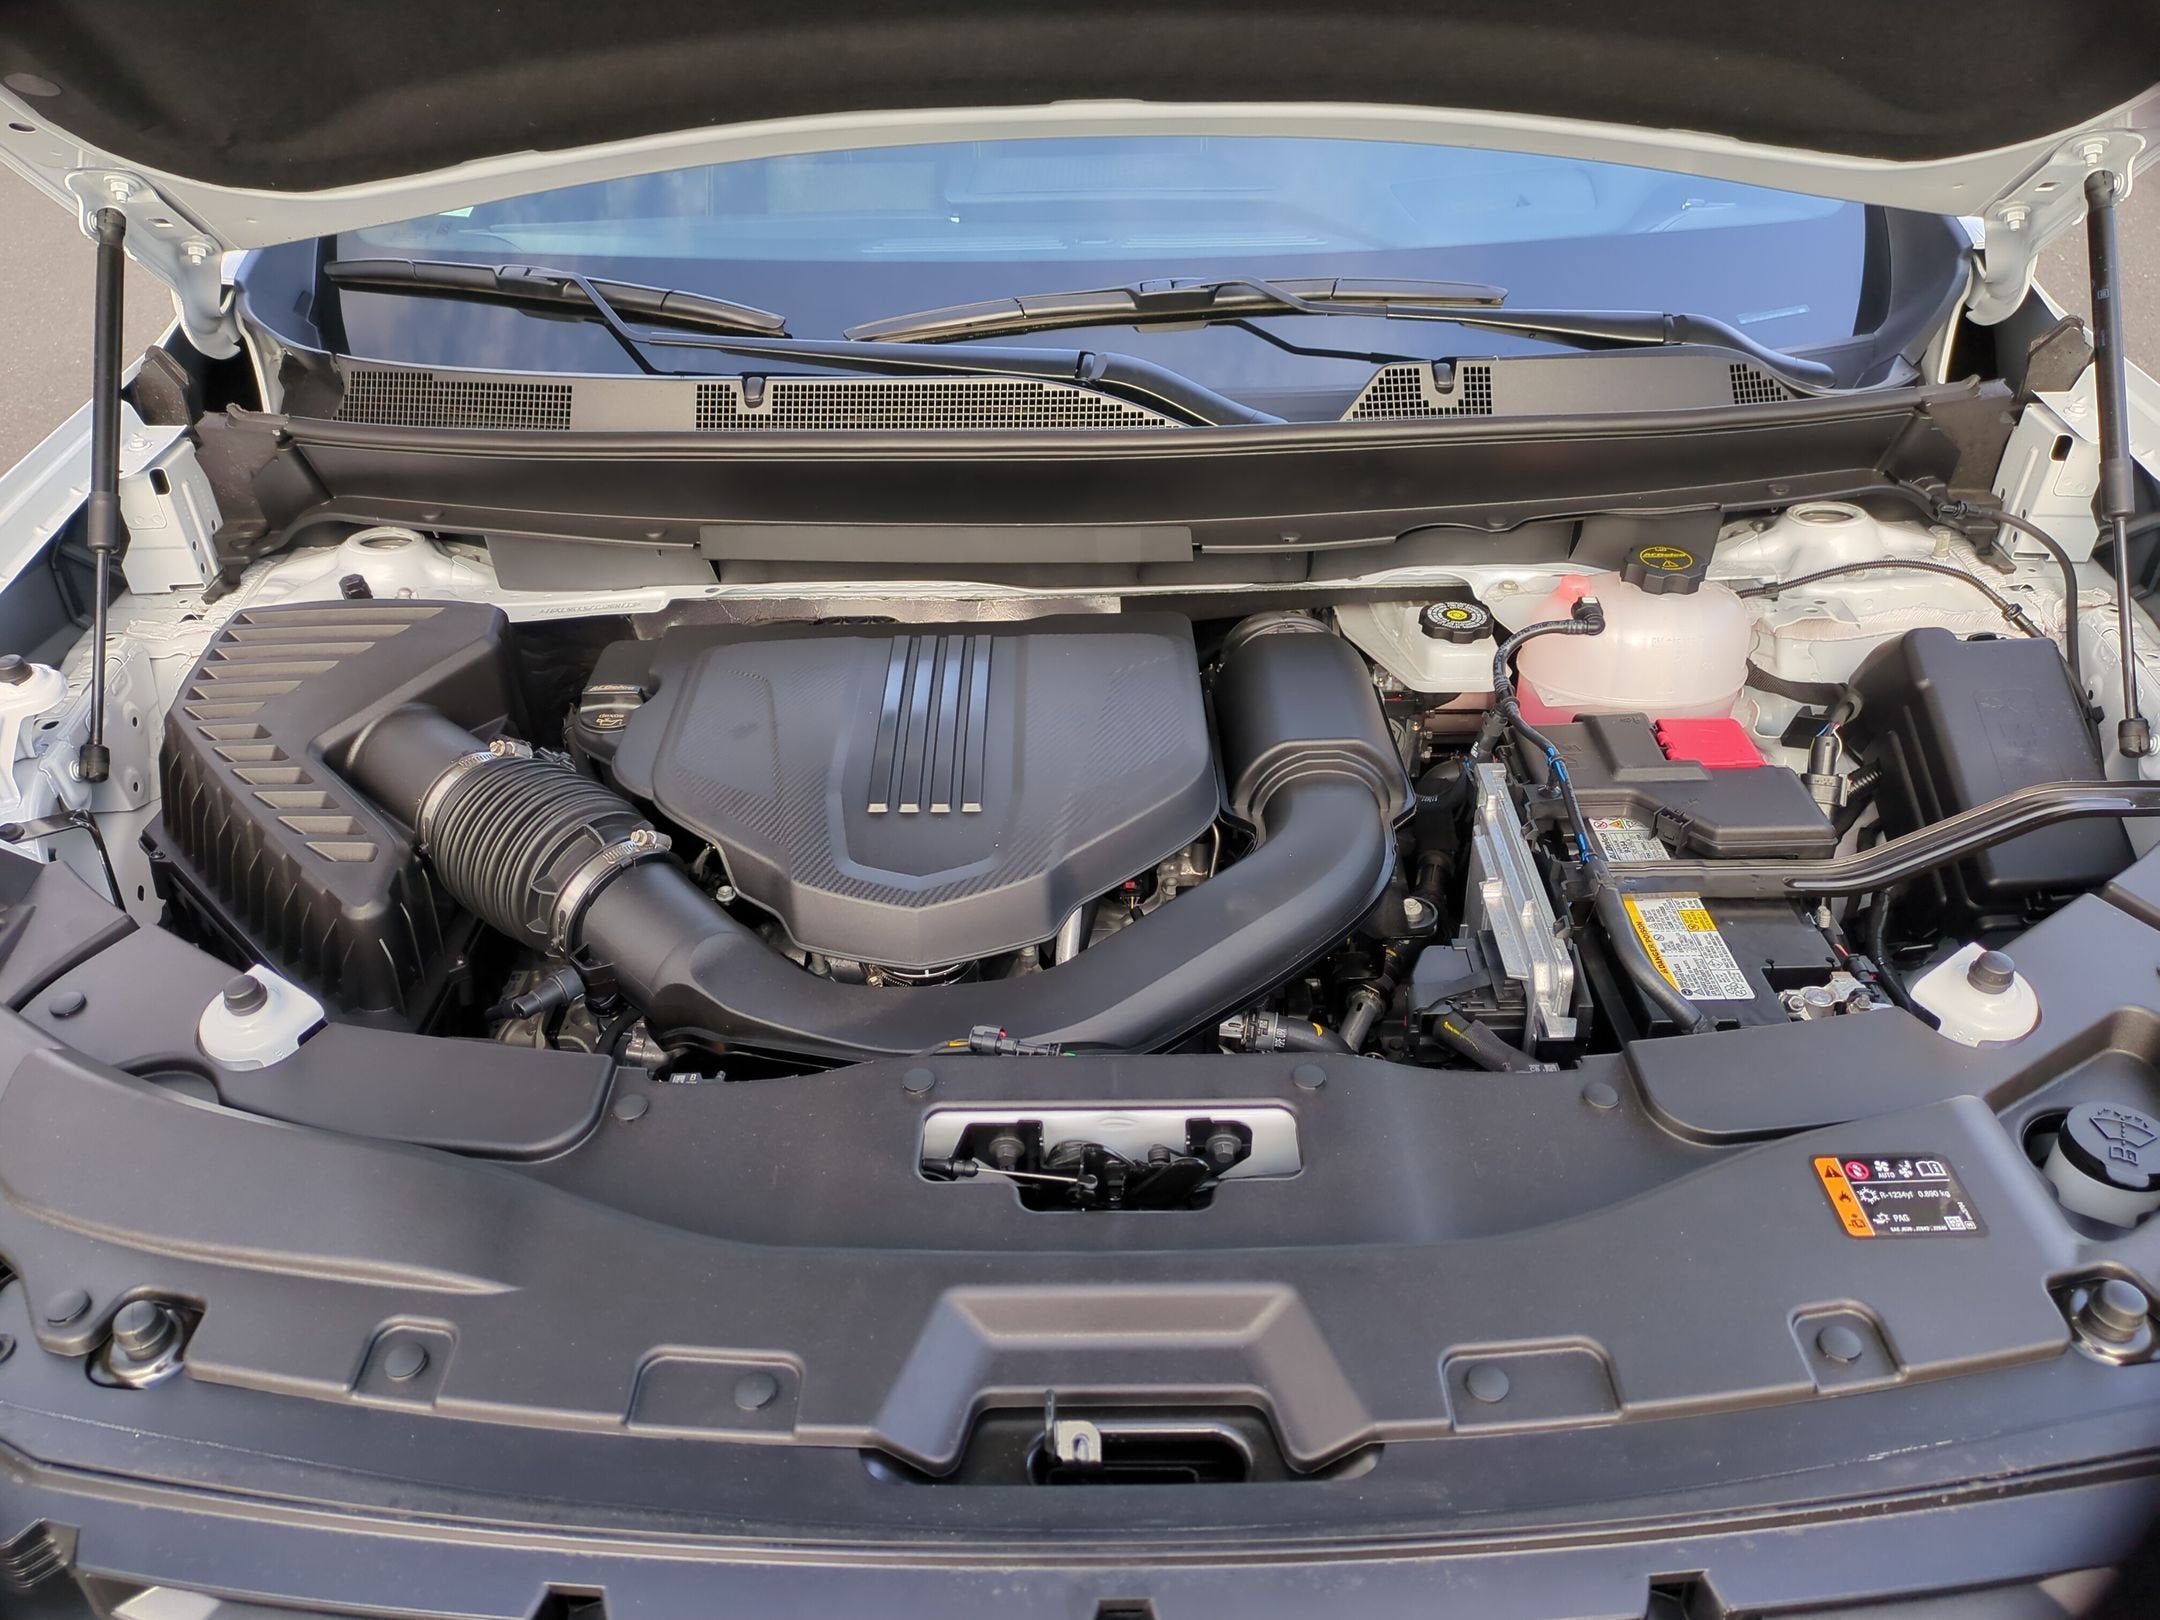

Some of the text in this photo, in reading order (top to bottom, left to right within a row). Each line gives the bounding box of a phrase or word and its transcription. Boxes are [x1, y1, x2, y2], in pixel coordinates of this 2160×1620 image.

[1636, 921, 1666, 969] DANGER POISON
[1877, 1171, 1896, 1179] AUTO
[1939, 1189, 1951, 1199] kg
[1892, 1213, 1911, 1223] PAG
